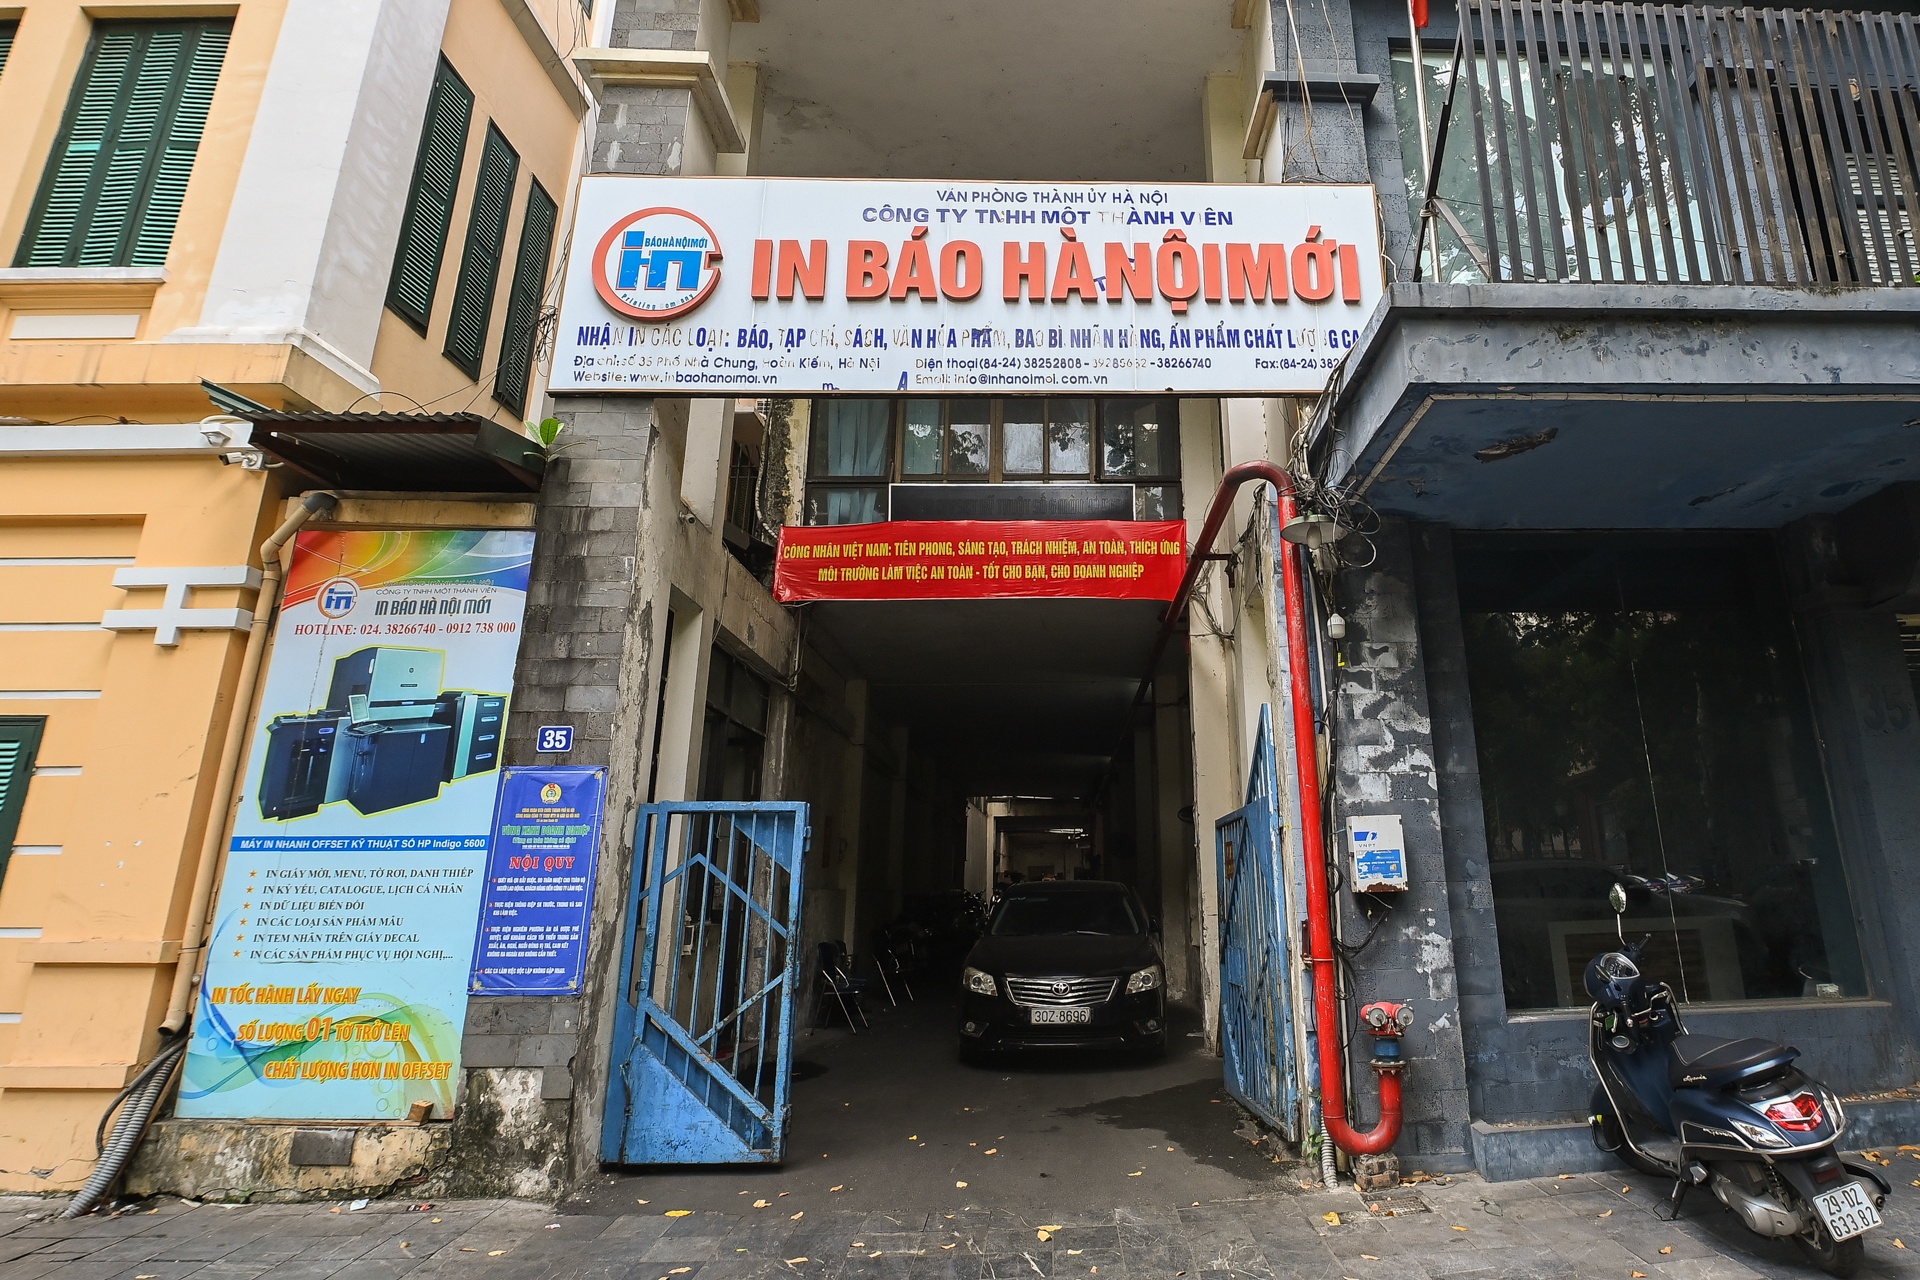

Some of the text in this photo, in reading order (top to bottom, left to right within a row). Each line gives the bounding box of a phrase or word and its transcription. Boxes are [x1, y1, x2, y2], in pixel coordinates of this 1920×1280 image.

[972, 187, 1168, 206] PHÒNG THÀNH ỦY HÀ NỘI
[863, 204, 929, 223] CÔNG
[936, 208, 967, 223] TY
[975, 209, 1035, 224] TNHH
[1098, 207, 1174, 225] THÀNH
[751, 239, 828, 301] IN
[845, 226, 983, 302] BÁO
[577, 321, 625, 350] NHẬN
[628, 326, 646, 347] IN
[651, 322, 682, 347] CÁC
[737, 323, 773, 351] BÁO,
[778, 327, 806, 353] TẠP
[845, 324, 888, 351] SÁCH,
[1015, 328, 1044, 349] BAO
[1070, 324, 1113, 349] NHÃN
[1170, 322, 1191, 349] ẤN
[1195, 320, 1240, 349] PHẨM
[714, 356, 758, 371] Chung,
[784, 542, 810, 558] CÔNG
[813, 542, 840, 558] NHÂN
[843, 541, 864, 560] VIỆT
[866, 542, 892, 557] NAM:
[894, 540, 917, 557] TIÊN
[919, 541, 955, 558] PHONG,
[958, 539, 985, 556] SÁNG
[987, 541, 1008, 559] TẠO,
[1011, 538, 1042, 556] TRÁCH
[1045, 539, 1080, 558] NHIỆM,
[1082, 541, 1097, 555] AN
[1099, 538, 1128, 556] TOÀN,
[1130, 538, 1158, 555] THÍCH
[818, 561, 1145, 583] MÔI TRƯỜNG LÀM VIỆC AN TOÀN TỐT CHO BẠN, CHO DOANH NGHIỆP
[391, 596, 418, 616] BÁO
[419, 596, 438, 615] HÀ
[439, 596, 461, 617] NỘI
[463, 595, 492, 615] MỚI
[294, 622, 516, 636] HOTLINE: 024. 38266740 0912 738 000
[543, 730, 567, 748] 35
[240, 838, 263, 849] MÁY
[263, 839, 275, 849] IN
[275, 840, 310, 849] NHANH
[311, 839, 350, 849] OFFSET
[351, 837, 366, 849] KỸ
[367, 839, 400, 850] THUẬT
[417, 839, 431, 848] HP
[433, 839, 461, 850] Indigo
[463, 838, 486, 848] 5600
[509, 853, 575, 873] NỘI QUY
[266, 869, 278, 879] IN
[333, 869, 367, 880] MENU,
[410, 869, 440, 878] DANH
[263, 882, 464, 896] IN CATALOGUE, LỊCH CÁ NHÂN
[260, 901, 272, 911] IN
[291, 899, 316, 912] LIỆU
[256, 917, 268, 927] IN
[270, 915, 292, 927] CÁC
[294, 917, 321, 929] LOẠI
[253, 933, 265, 943] IN
[267, 933, 290, 943] TEM
[292, 932, 322, 943] NHÃN
[325, 931, 353, 943] TRÊN
[384, 933, 420, 943] DECAL
[250, 950, 262, 960] IN
[264, 948, 286, 960] CÁC
[344, 950, 374, 961] PHỤC
[376, 950, 391, 961] VỤ
[393, 949, 413, 961] HỘI
[210, 982, 362, 1005] IN TỐC HÀNH LẤY NGAY
[236, 1018, 260, 1042] SỐ
[257, 1021, 304, 1046] LƯỢNG
[305, 1016, 333, 1043] 01
[335, 1020, 355, 1042] TỜ
[383, 1021, 411, 1043] LÊN
[264, 1056, 453, 1084] CHẤT LƯỢNG HƠN IN OFFSET
[1823, 1188, 1863, 1216] 29-D2
[1830, 1206, 1879, 1237] 633.82
